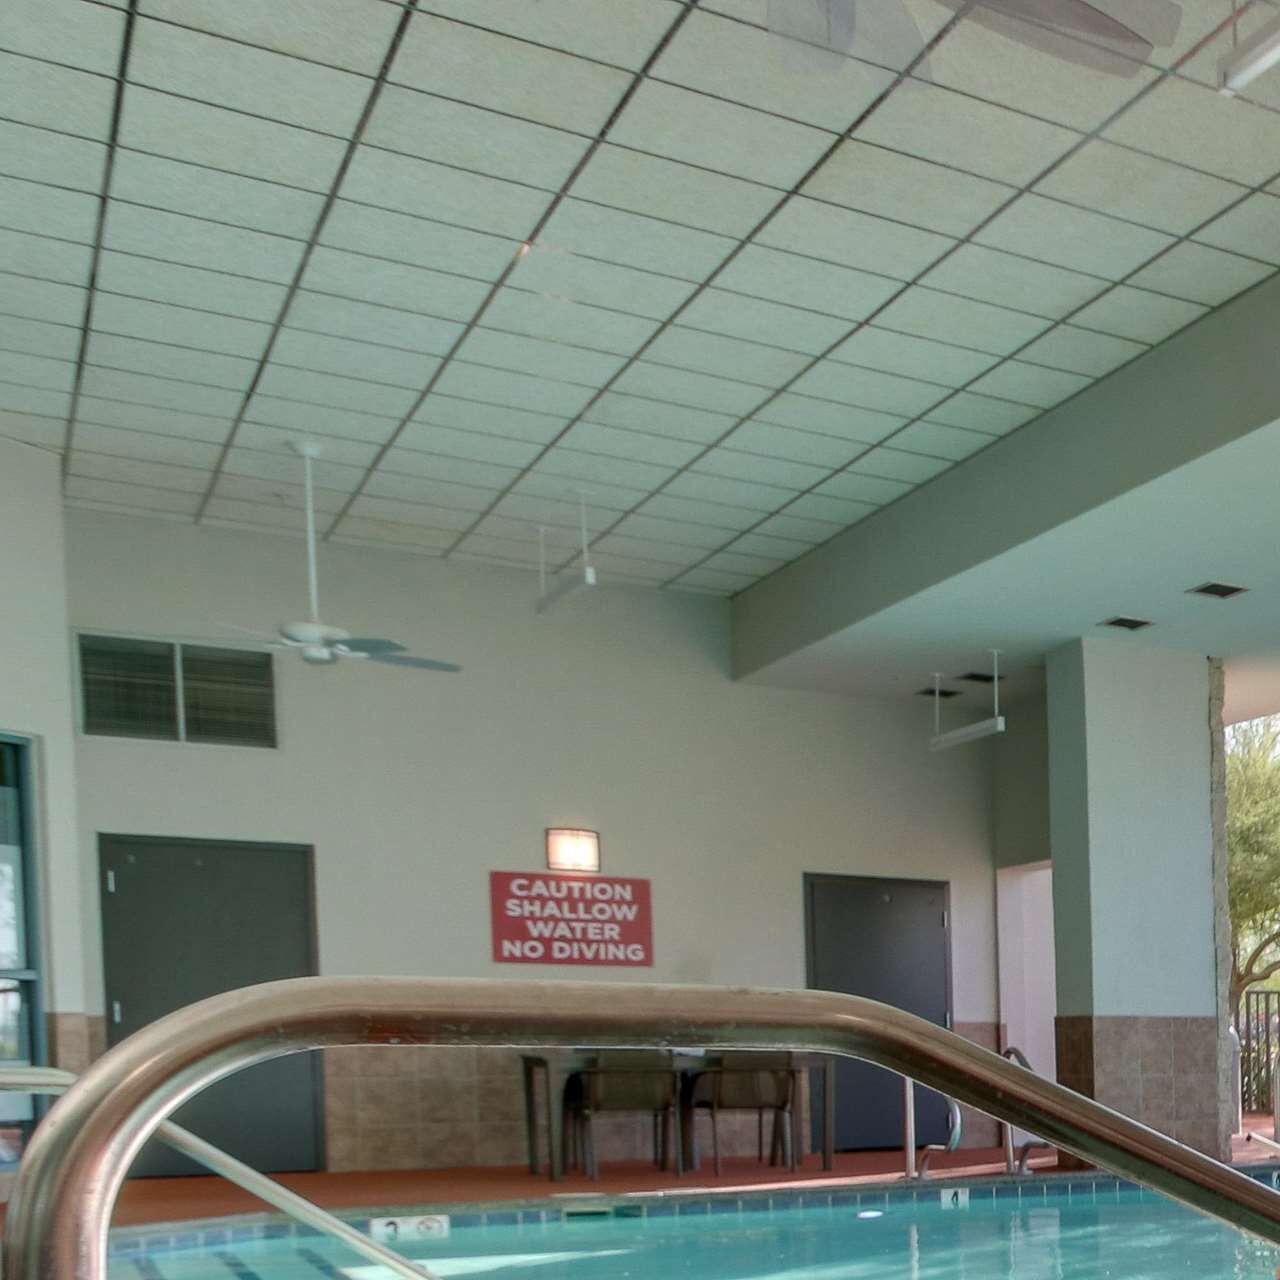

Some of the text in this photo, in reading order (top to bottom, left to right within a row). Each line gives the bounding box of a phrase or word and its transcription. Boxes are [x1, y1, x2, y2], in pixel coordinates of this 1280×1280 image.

[510, 879, 632, 900] CAUTION
[505, 899, 638, 921] SHALLOW
[526, 920, 621, 940] WATER
[501, 940, 645, 961] NO DIVING
